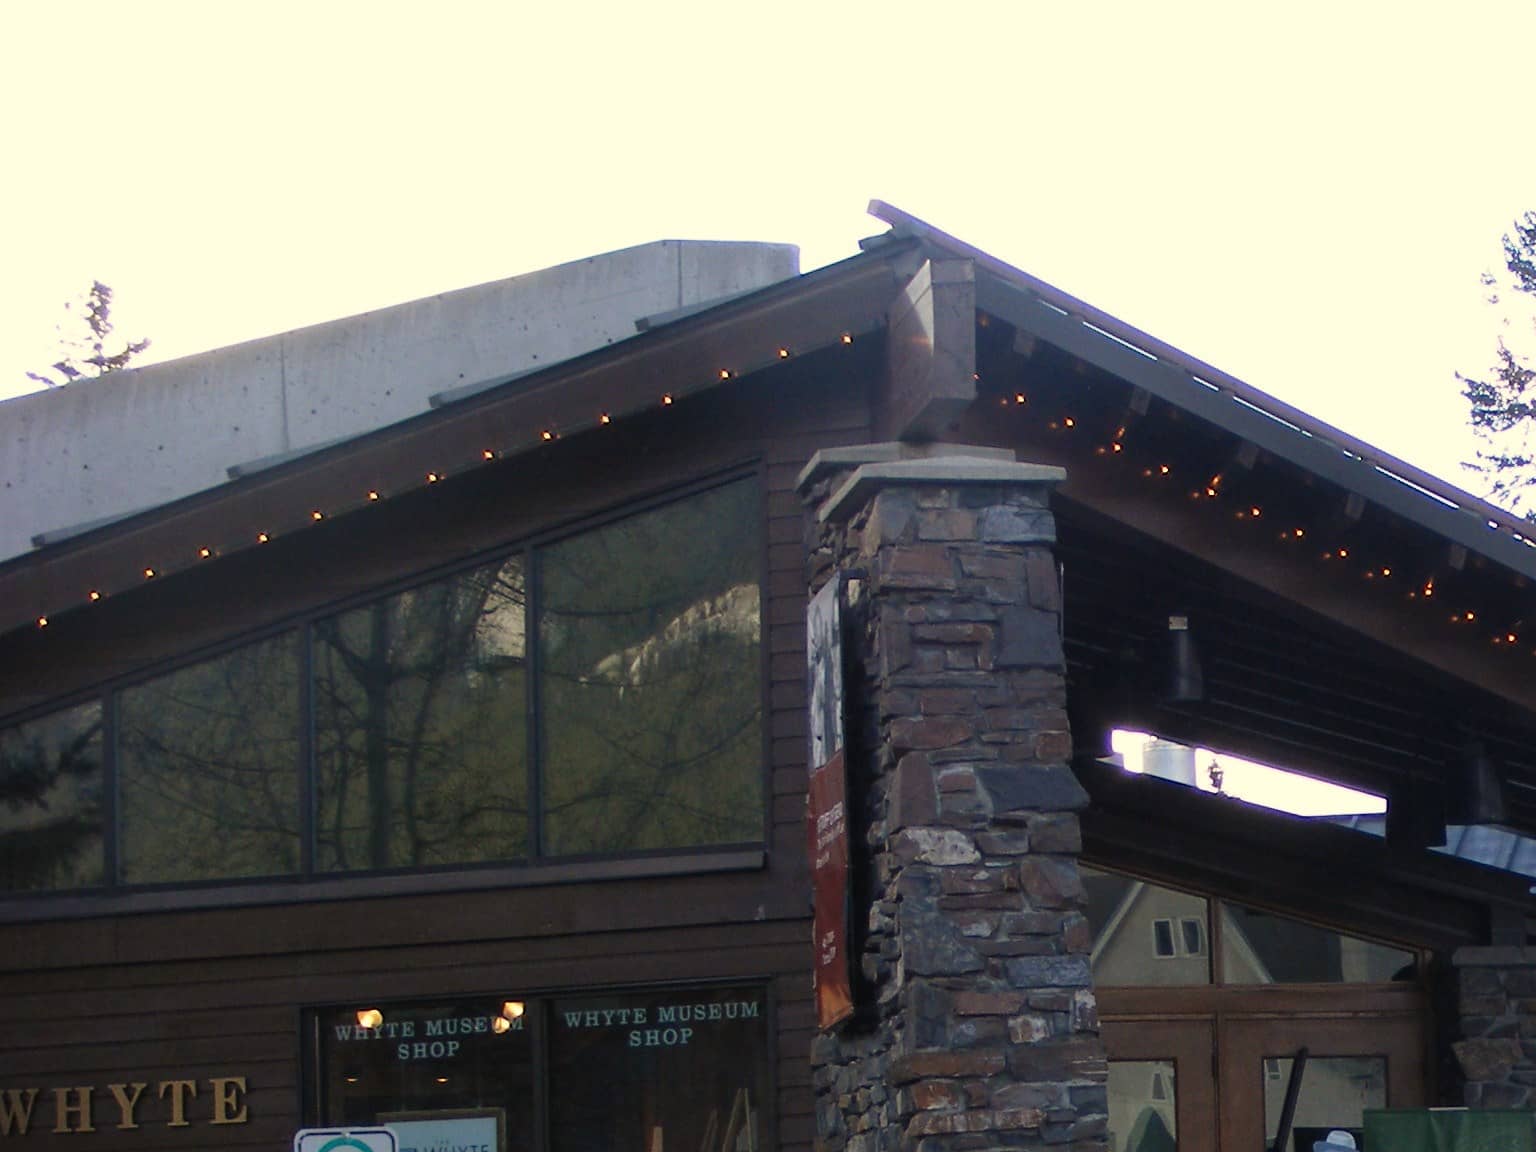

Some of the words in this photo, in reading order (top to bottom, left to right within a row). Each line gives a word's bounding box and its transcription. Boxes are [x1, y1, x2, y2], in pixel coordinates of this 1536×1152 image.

[564, 1008, 648, 1028] WHYTE
[658, 1001, 760, 1023] MUSEUM
[335, 1020, 416, 1042] WHYTE
[425, 1016, 525, 1037] MUSEM
[629, 1027, 694, 1048] SHOP
[397, 1040, 461, 1061] SHOP
[0, 1076, 249, 1136] WHYTE
